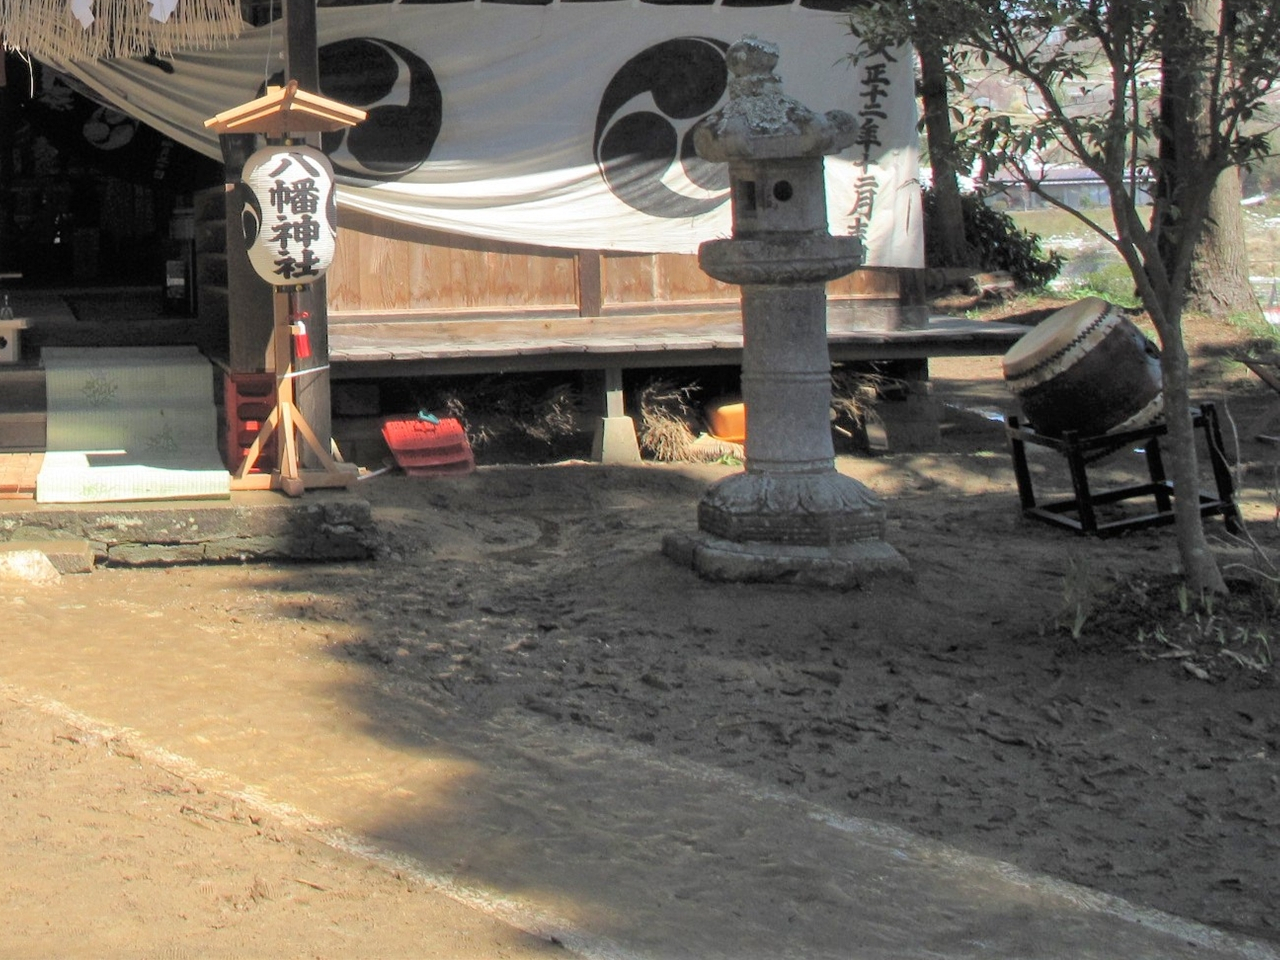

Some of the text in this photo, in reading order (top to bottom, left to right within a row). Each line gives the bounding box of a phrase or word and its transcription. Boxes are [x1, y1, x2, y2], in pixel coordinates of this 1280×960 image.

[268, 151, 322, 280] 八幡神社
[846, 30, 899, 264] 大正十二年十二月吉
